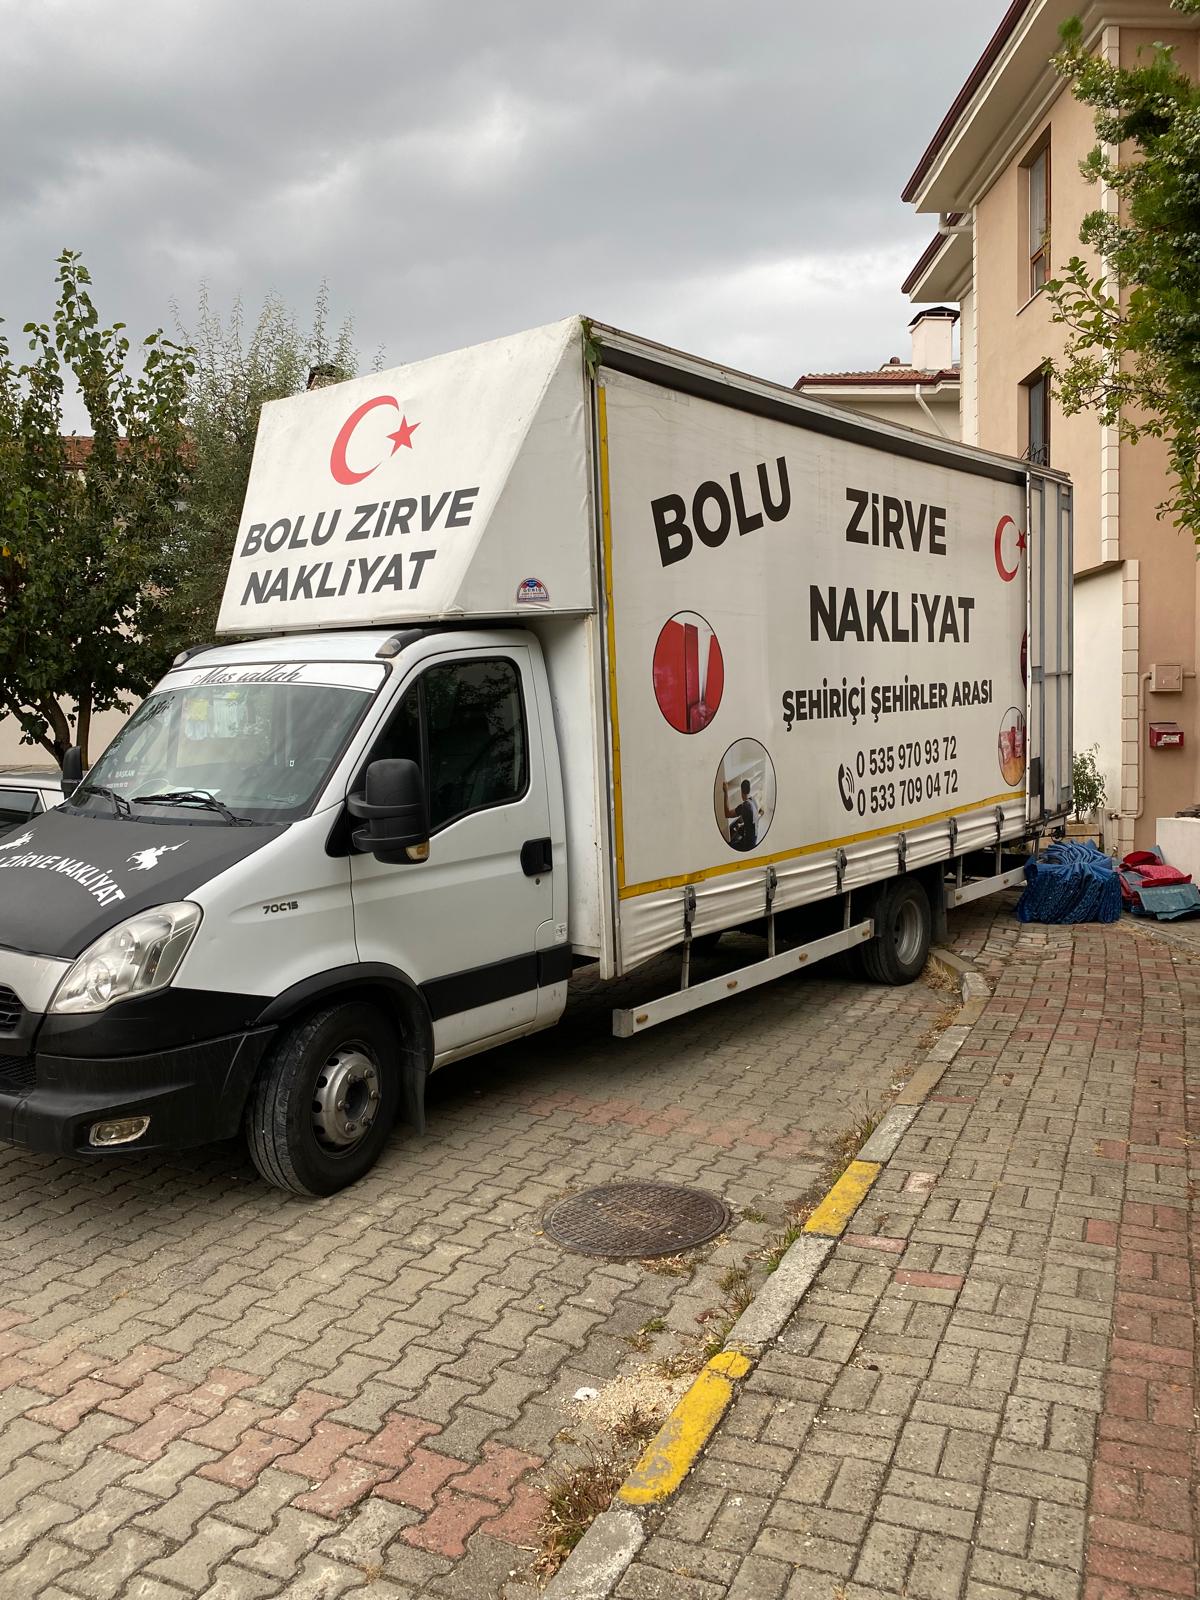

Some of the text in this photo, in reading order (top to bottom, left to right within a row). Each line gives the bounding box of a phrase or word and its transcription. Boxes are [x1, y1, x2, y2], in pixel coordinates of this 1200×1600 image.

[240, 509, 342, 557] BOLU
[651, 456, 791, 568] BOLU
[782, 675, 993, 732] ŞEHİRİÇİ ŞEHİRLER ARASI
[856, 735, 957, 778] 0 535 970 93 72
[857, 769, 959, 817] 0 533 709 04 72
[49, 858, 126, 907] NAKLİYAT
[262, 900, 299, 915] 70C15
